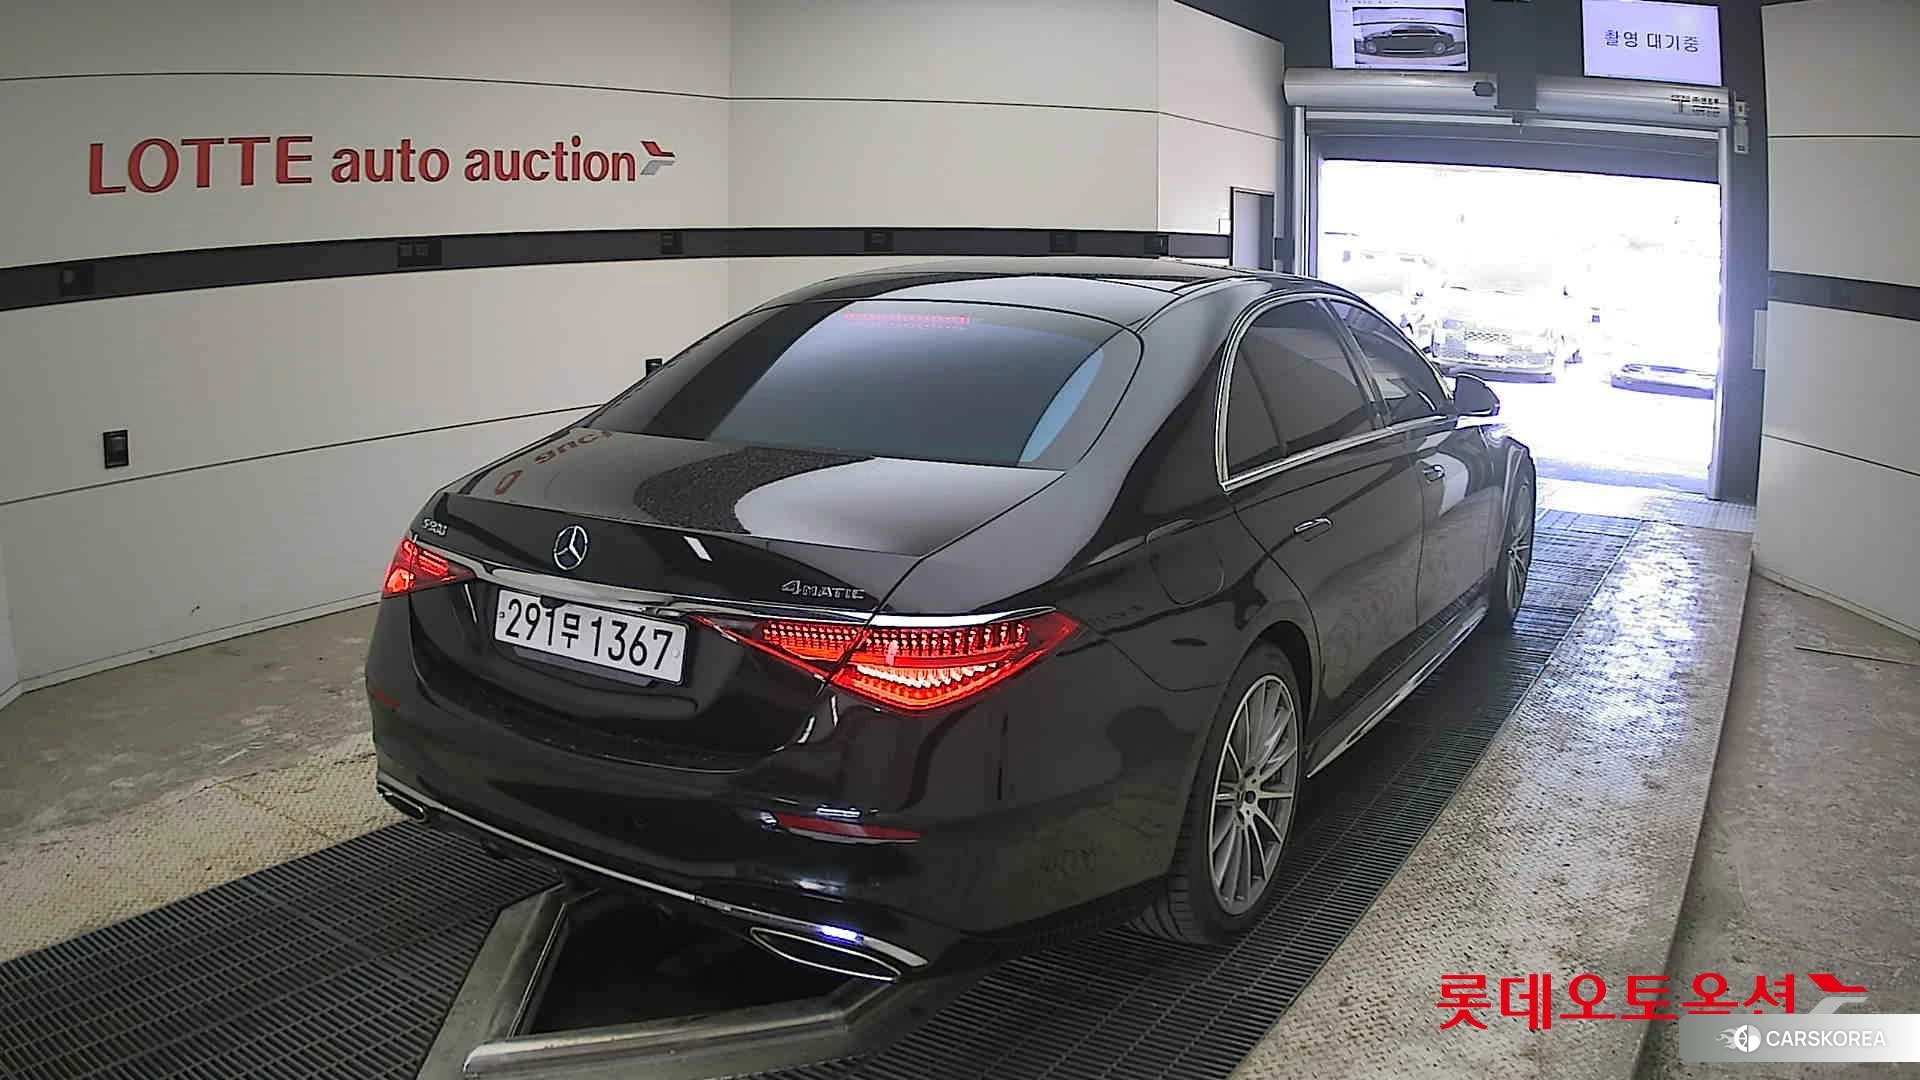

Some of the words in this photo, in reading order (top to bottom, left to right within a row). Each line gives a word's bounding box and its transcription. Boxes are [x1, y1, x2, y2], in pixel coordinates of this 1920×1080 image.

[1646, 32, 1699, 53] 대기중
[89, 135, 313, 195] LOTTE
[330, 138, 451, 183] auto
[463, 134, 637, 182] auction
[780, 579, 865, 600] 4MATIC
